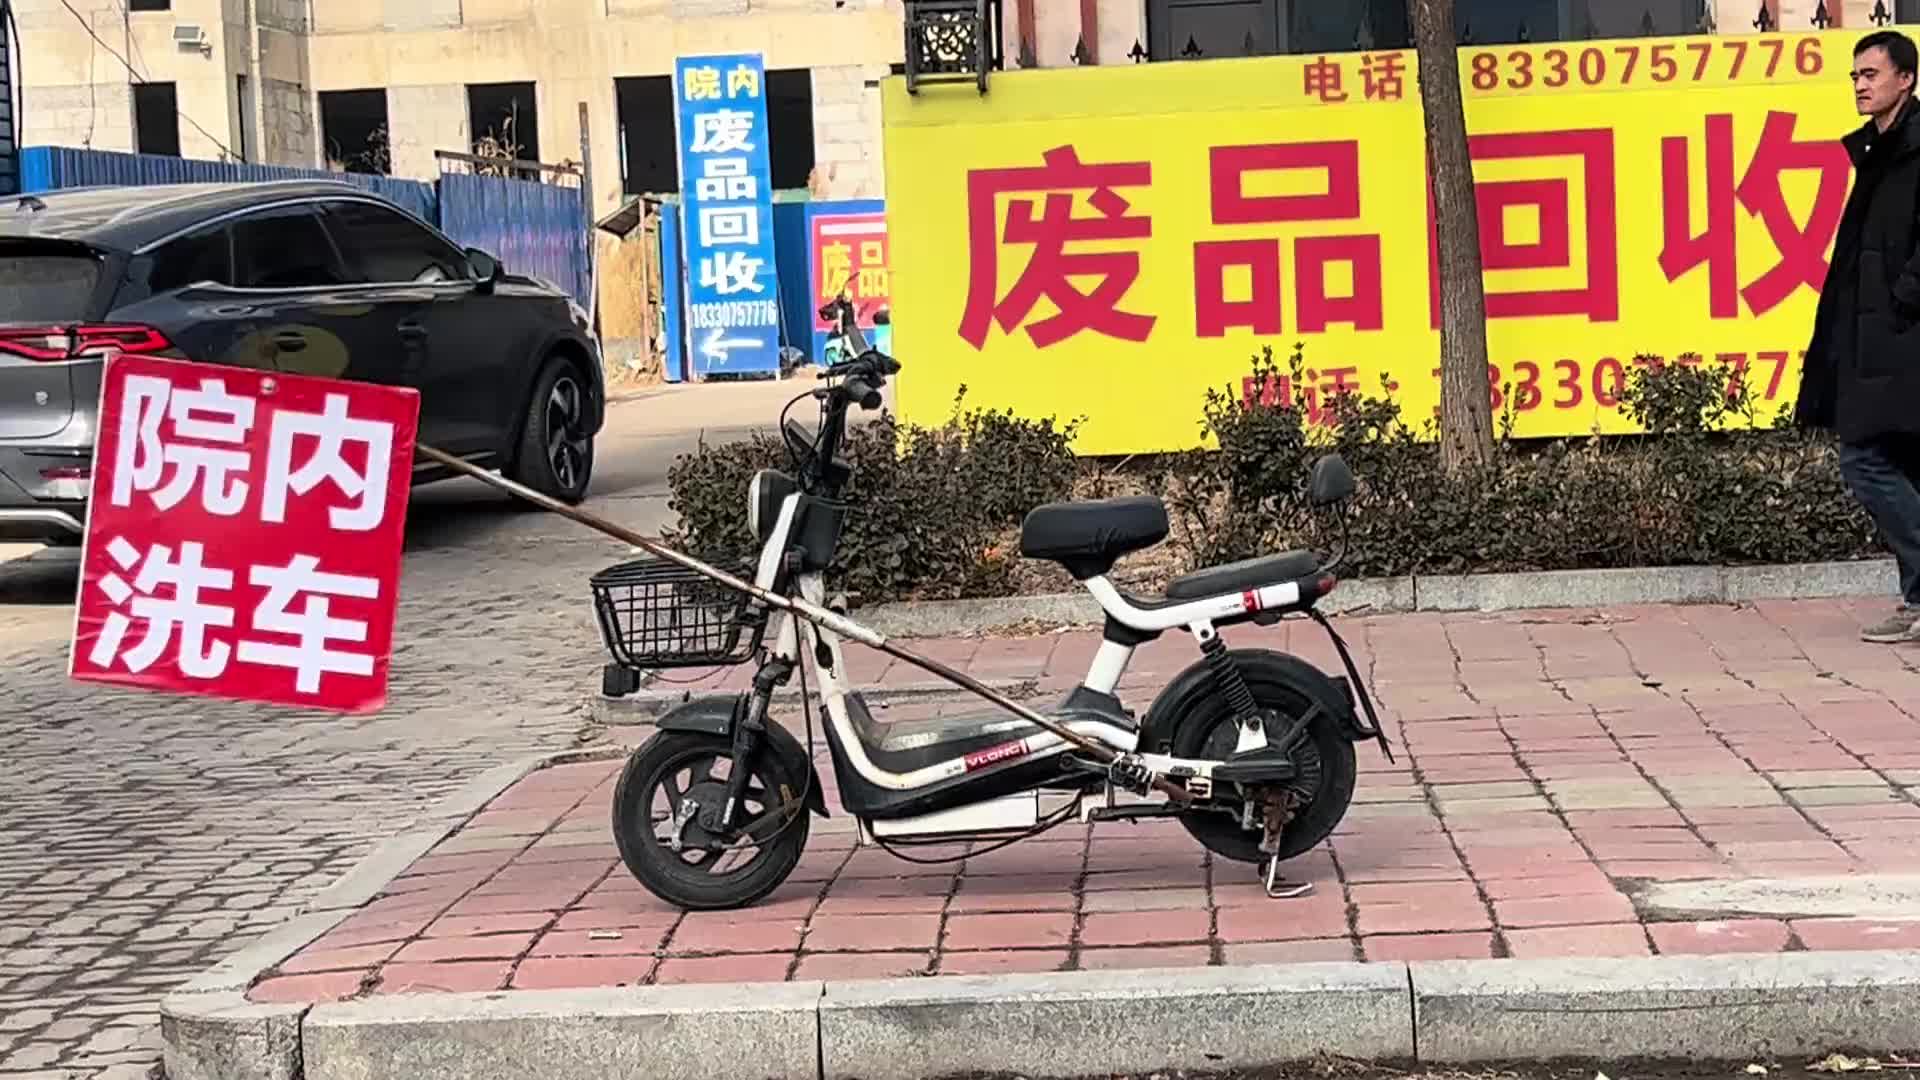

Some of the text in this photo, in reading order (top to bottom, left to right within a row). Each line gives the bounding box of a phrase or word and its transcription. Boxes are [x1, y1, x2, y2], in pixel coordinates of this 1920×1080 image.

[684, 64, 759, 100] 院内
[1303, 52, 1406, 102] 电话
[689, 108, 765, 295] 废品回收
[958, 111, 1852, 352] 废品回收
[692, 301, 776, 329] 18330757776
[822, 241, 888, 298] 废品
[110, 373, 394, 532] 院内
[89, 535, 380, 693] 洗车
